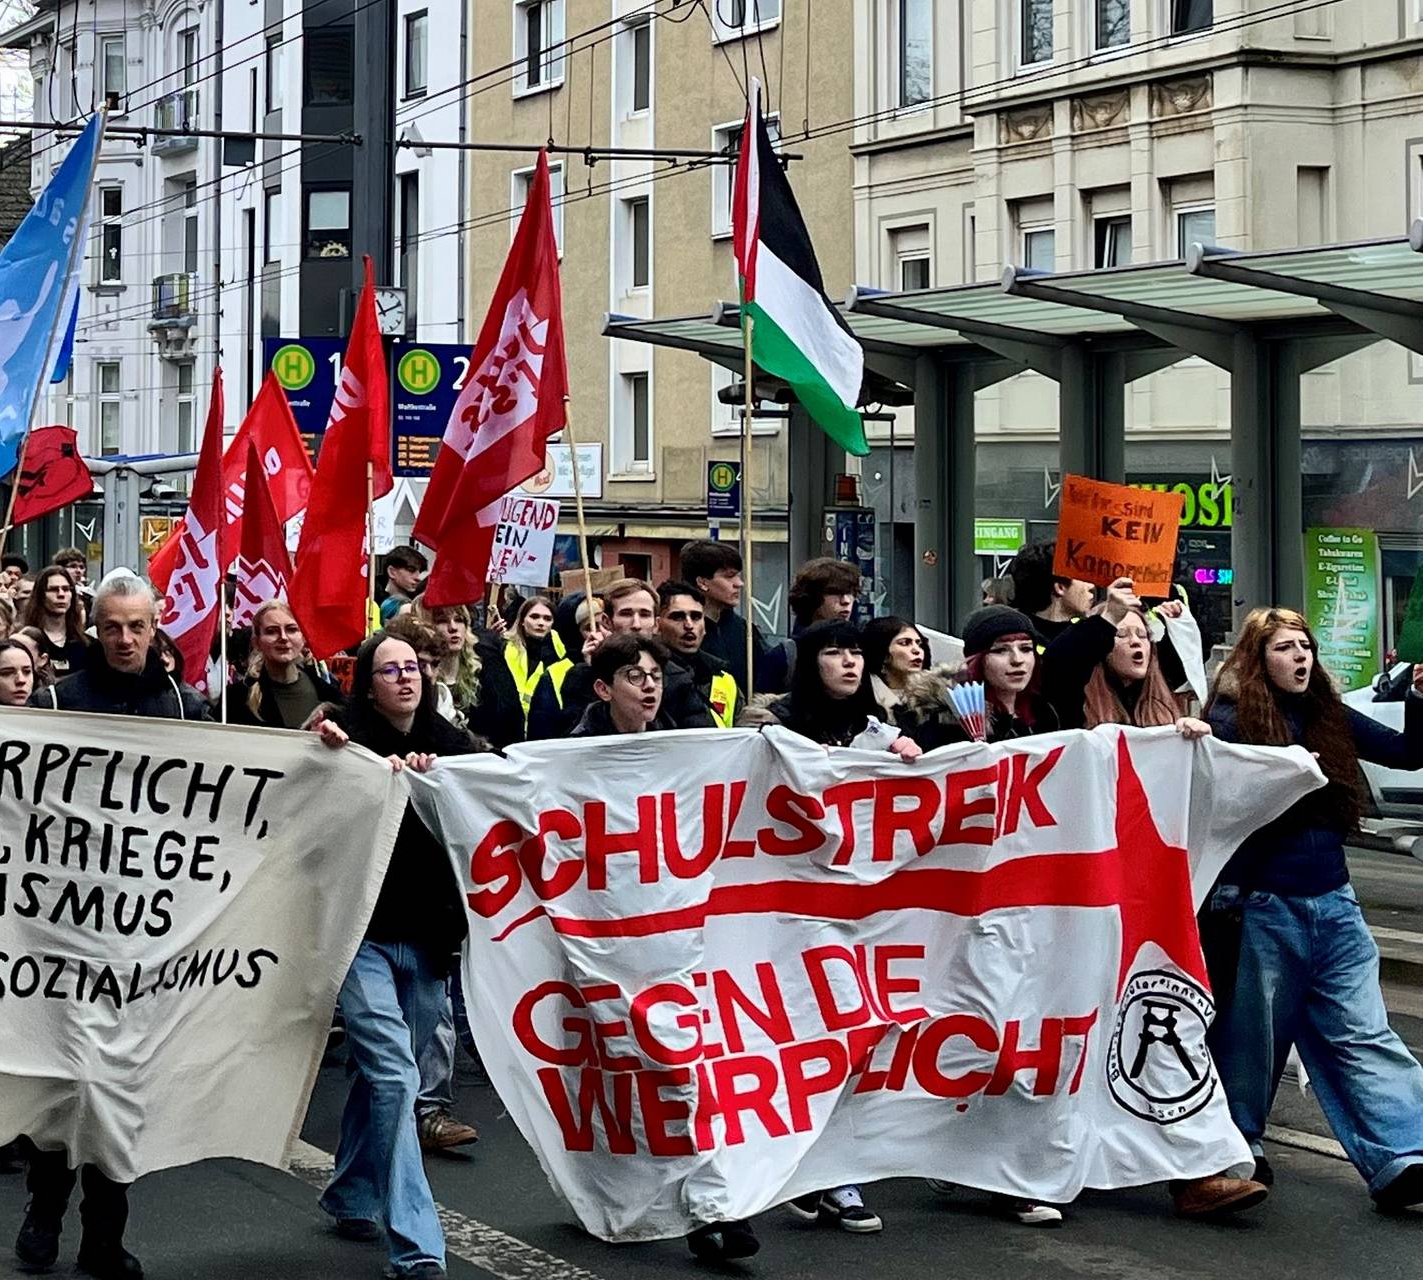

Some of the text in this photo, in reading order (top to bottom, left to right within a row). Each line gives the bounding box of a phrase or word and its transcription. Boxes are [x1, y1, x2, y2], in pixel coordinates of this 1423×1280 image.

[285, 354, 302, 380] H
[328, 352, 341, 386] 1
[411, 359, 427, 385] H
[452, 356, 471, 391] 2
[500, 496, 556, 531] UGEND
[1101, 516, 1165, 545] KEIN
[495, 524, 529, 549] EIN
[1318, 534, 1364, 544] Coffee to Go
[467, 745, 1065, 917] SCHULSTREIK
[25, 813, 232, 893] KRIEGE,
[512, 943, 931, 1074] GEGEN DIE
